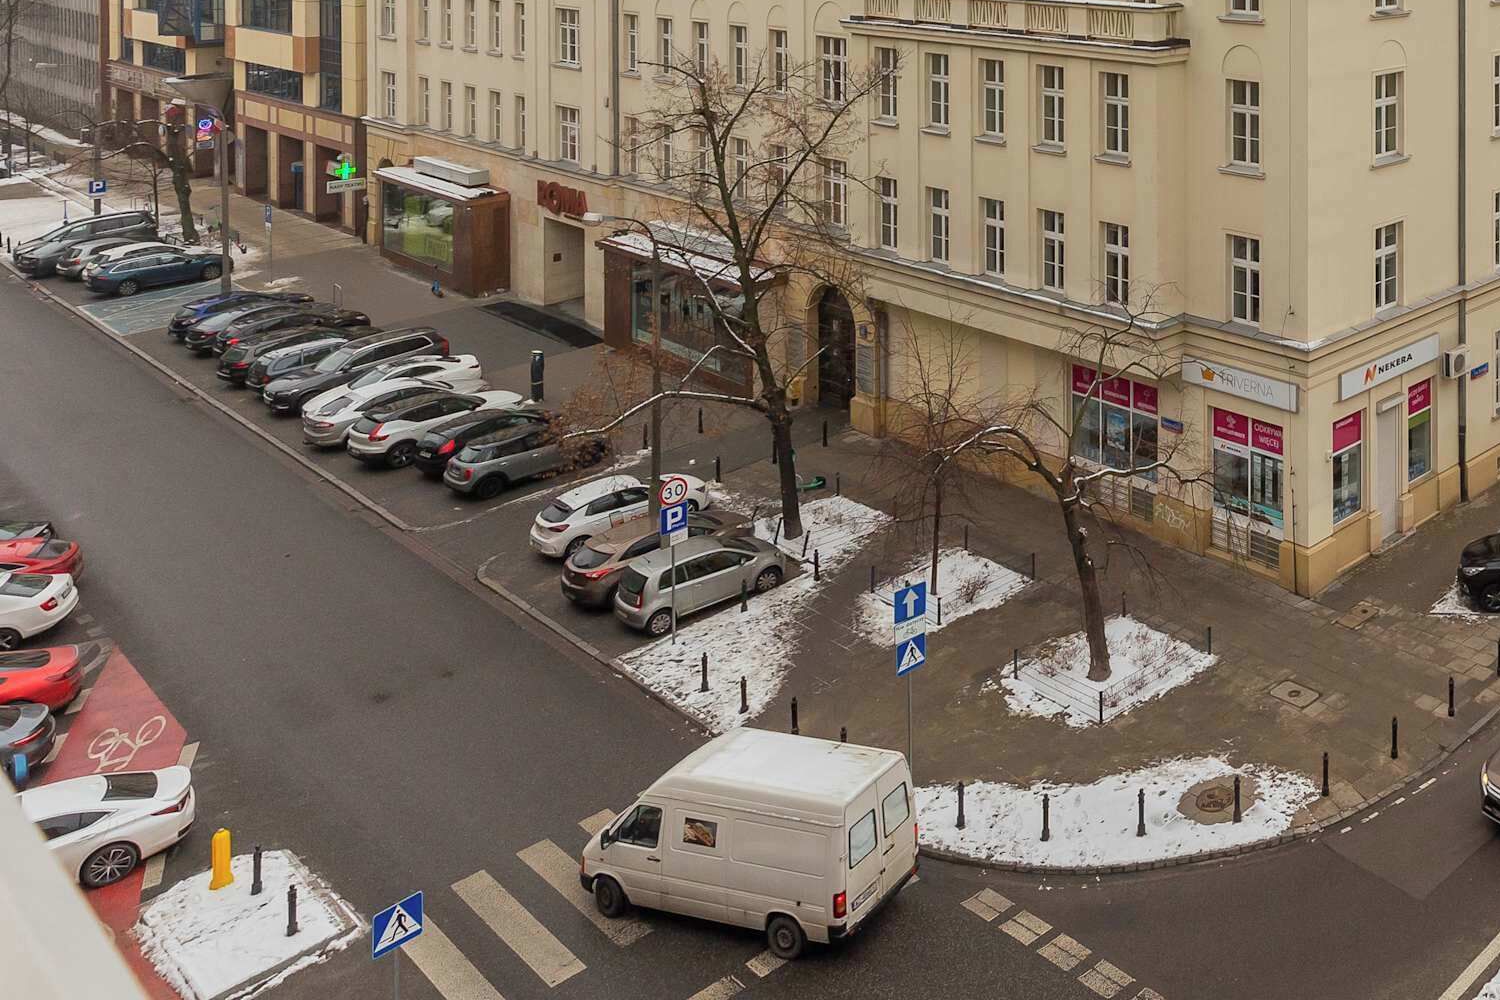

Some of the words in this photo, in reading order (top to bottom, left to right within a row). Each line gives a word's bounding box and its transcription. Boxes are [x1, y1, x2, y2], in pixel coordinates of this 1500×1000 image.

[92, 181, 104, 193] P
[537, 179, 588, 217] ROMA
[1377, 352, 1413, 375] NEKERA
[1220, 367, 1274, 399] TRIVERNA
[664, 483, 684, 500] 30
[666, 506, 683, 531] P
